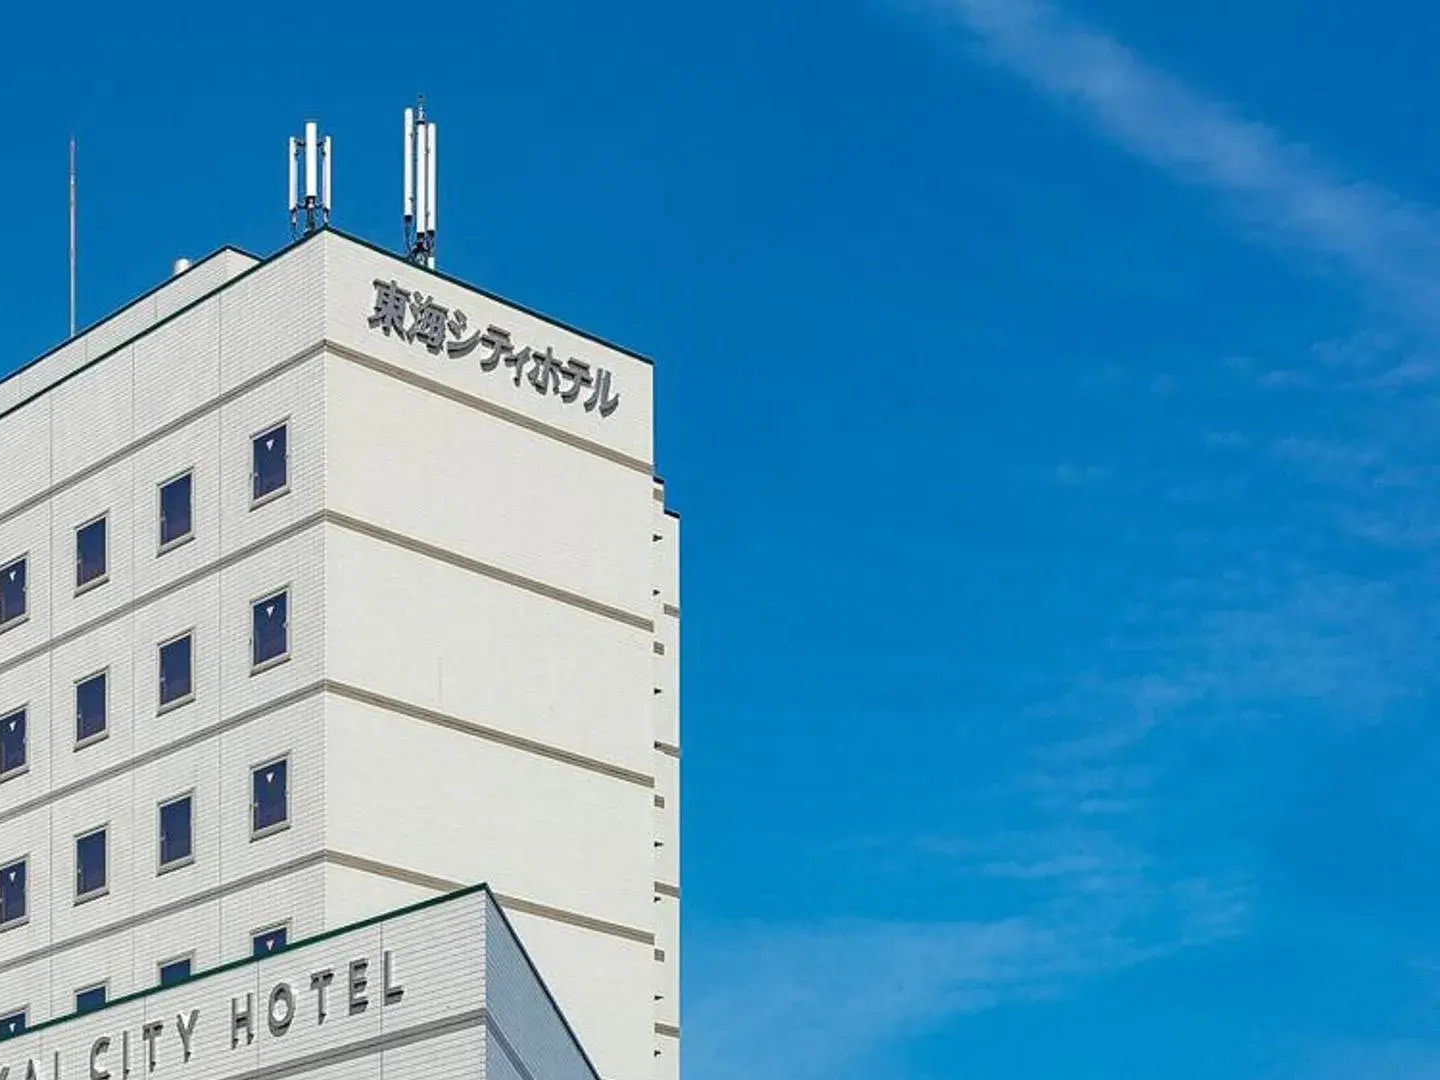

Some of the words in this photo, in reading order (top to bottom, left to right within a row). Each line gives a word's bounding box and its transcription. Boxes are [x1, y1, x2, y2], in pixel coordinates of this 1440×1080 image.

[367, 278, 620, 418] 東海シティホテル
[229, 949, 406, 1050] HOTEL
